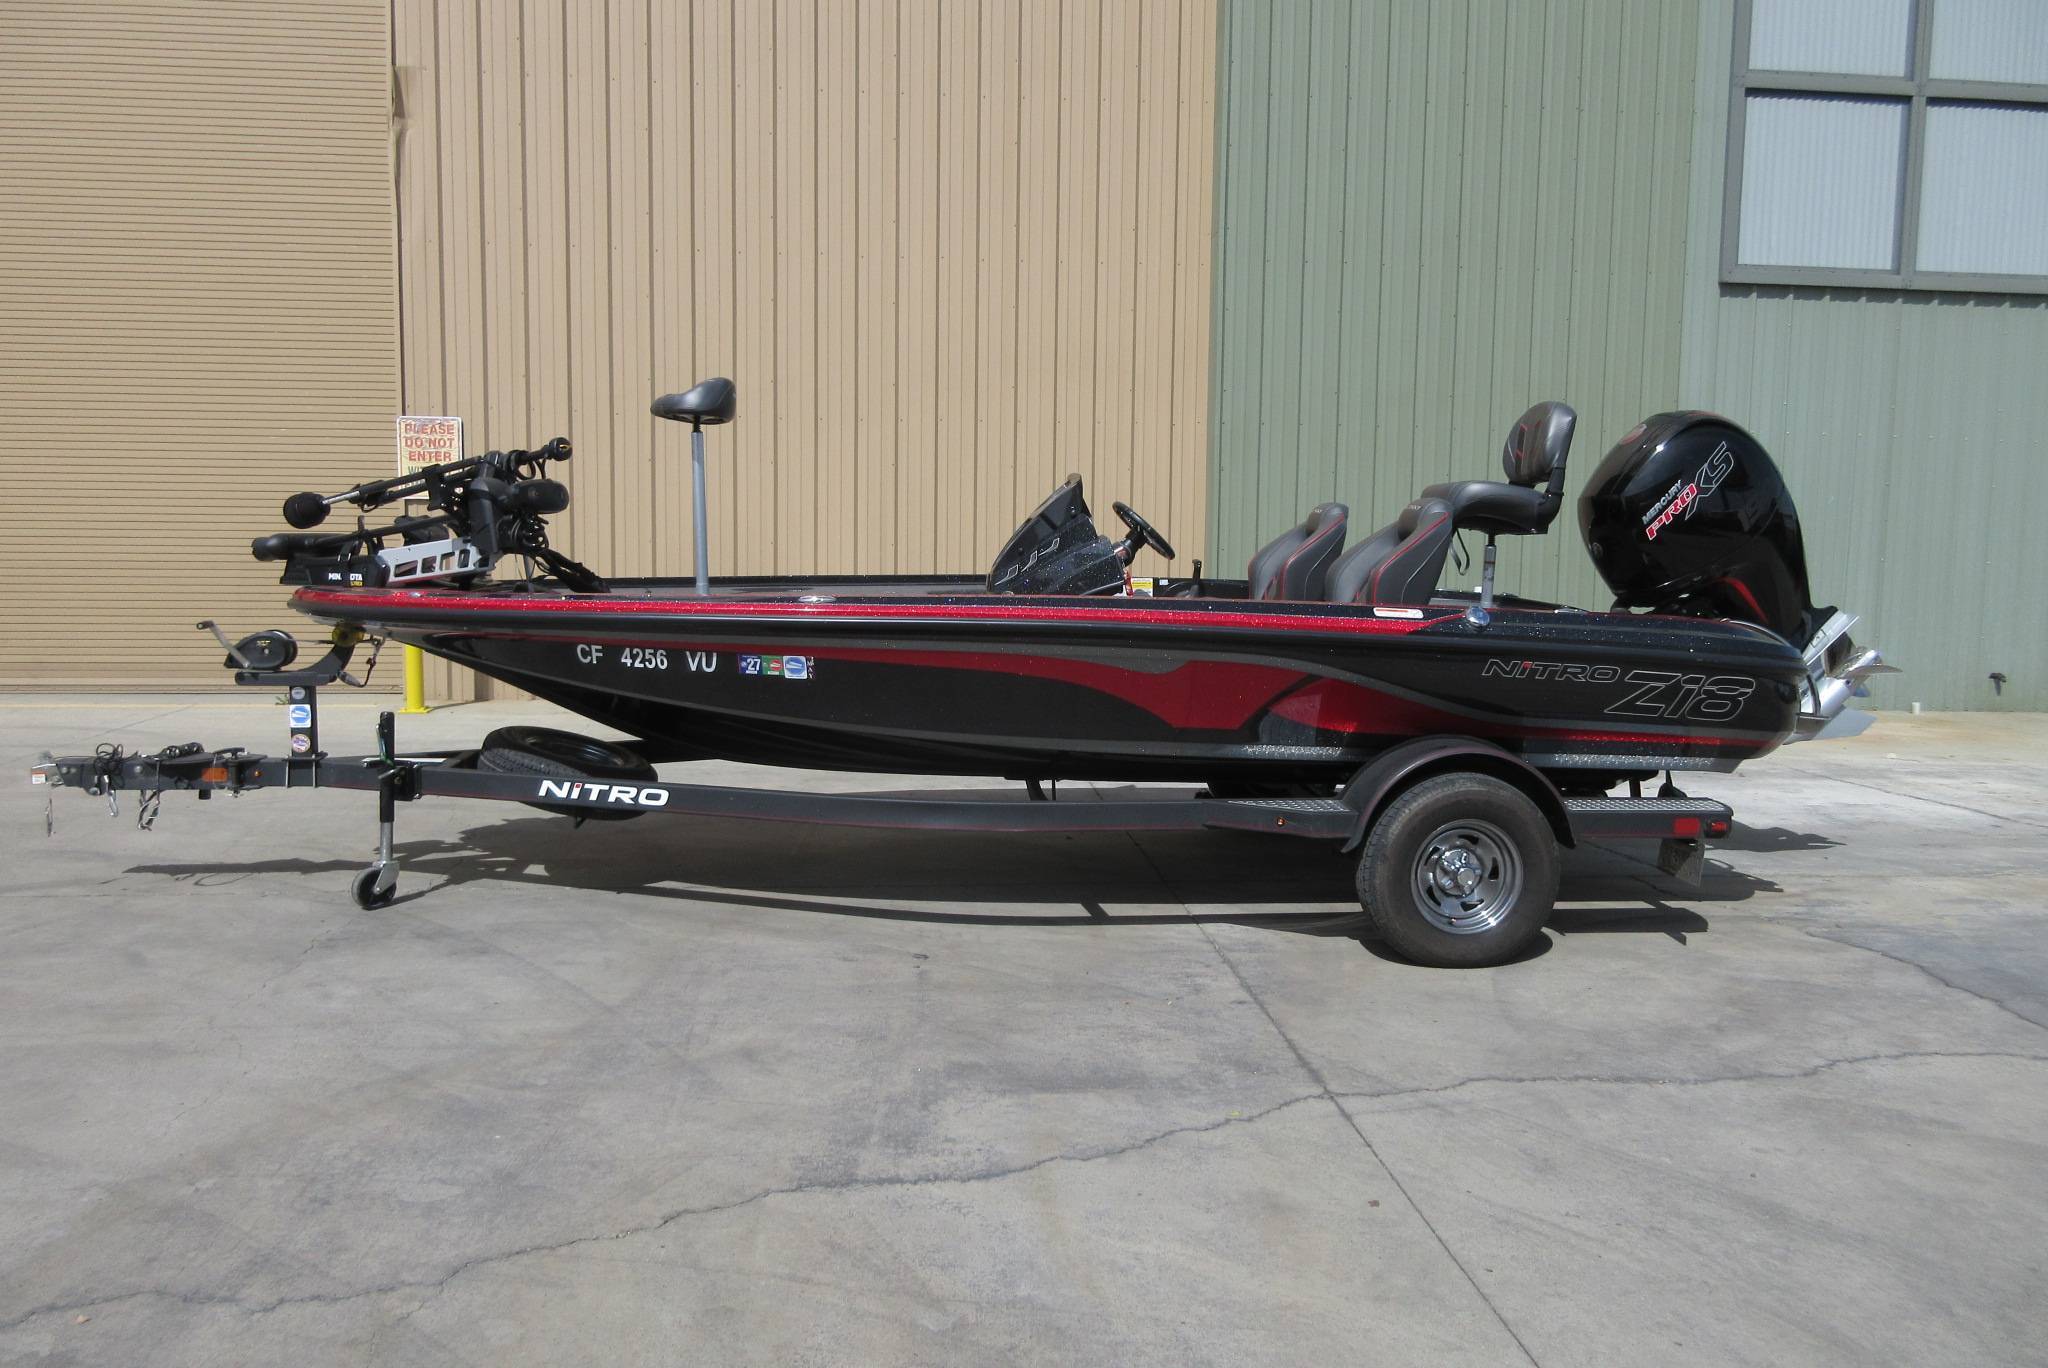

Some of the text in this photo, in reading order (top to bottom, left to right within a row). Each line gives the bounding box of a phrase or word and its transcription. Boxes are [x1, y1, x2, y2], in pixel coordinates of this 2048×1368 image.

[404, 423, 455, 435] PLEASE
[404, 437, 455, 449] DO NOT
[408, 451, 452, 462] ENTER
[1642, 480, 1683, 524] MERCURY
[1645, 482, 1698, 541] PRO
[576, 644, 718, 673] CF 4256 VU
[747, 658, 761, 671] 27
